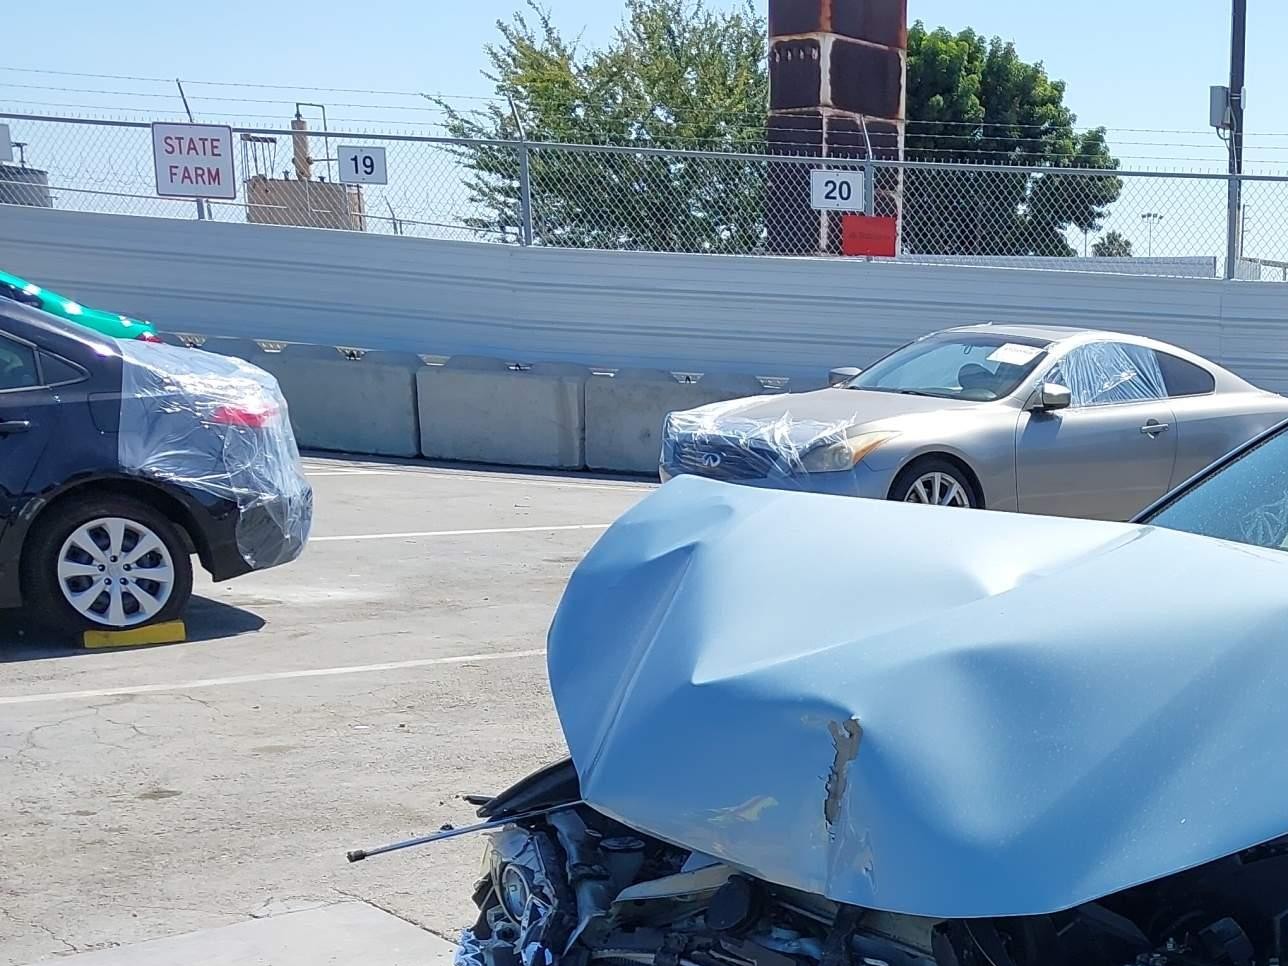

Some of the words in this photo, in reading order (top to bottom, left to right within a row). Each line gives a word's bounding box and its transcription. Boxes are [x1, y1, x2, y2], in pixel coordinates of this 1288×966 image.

[164, 135, 222, 157] STATE
[169, 165, 221, 186] FARM
[350, 155, 375, 176] 19
[824, 180, 852, 201] 20
